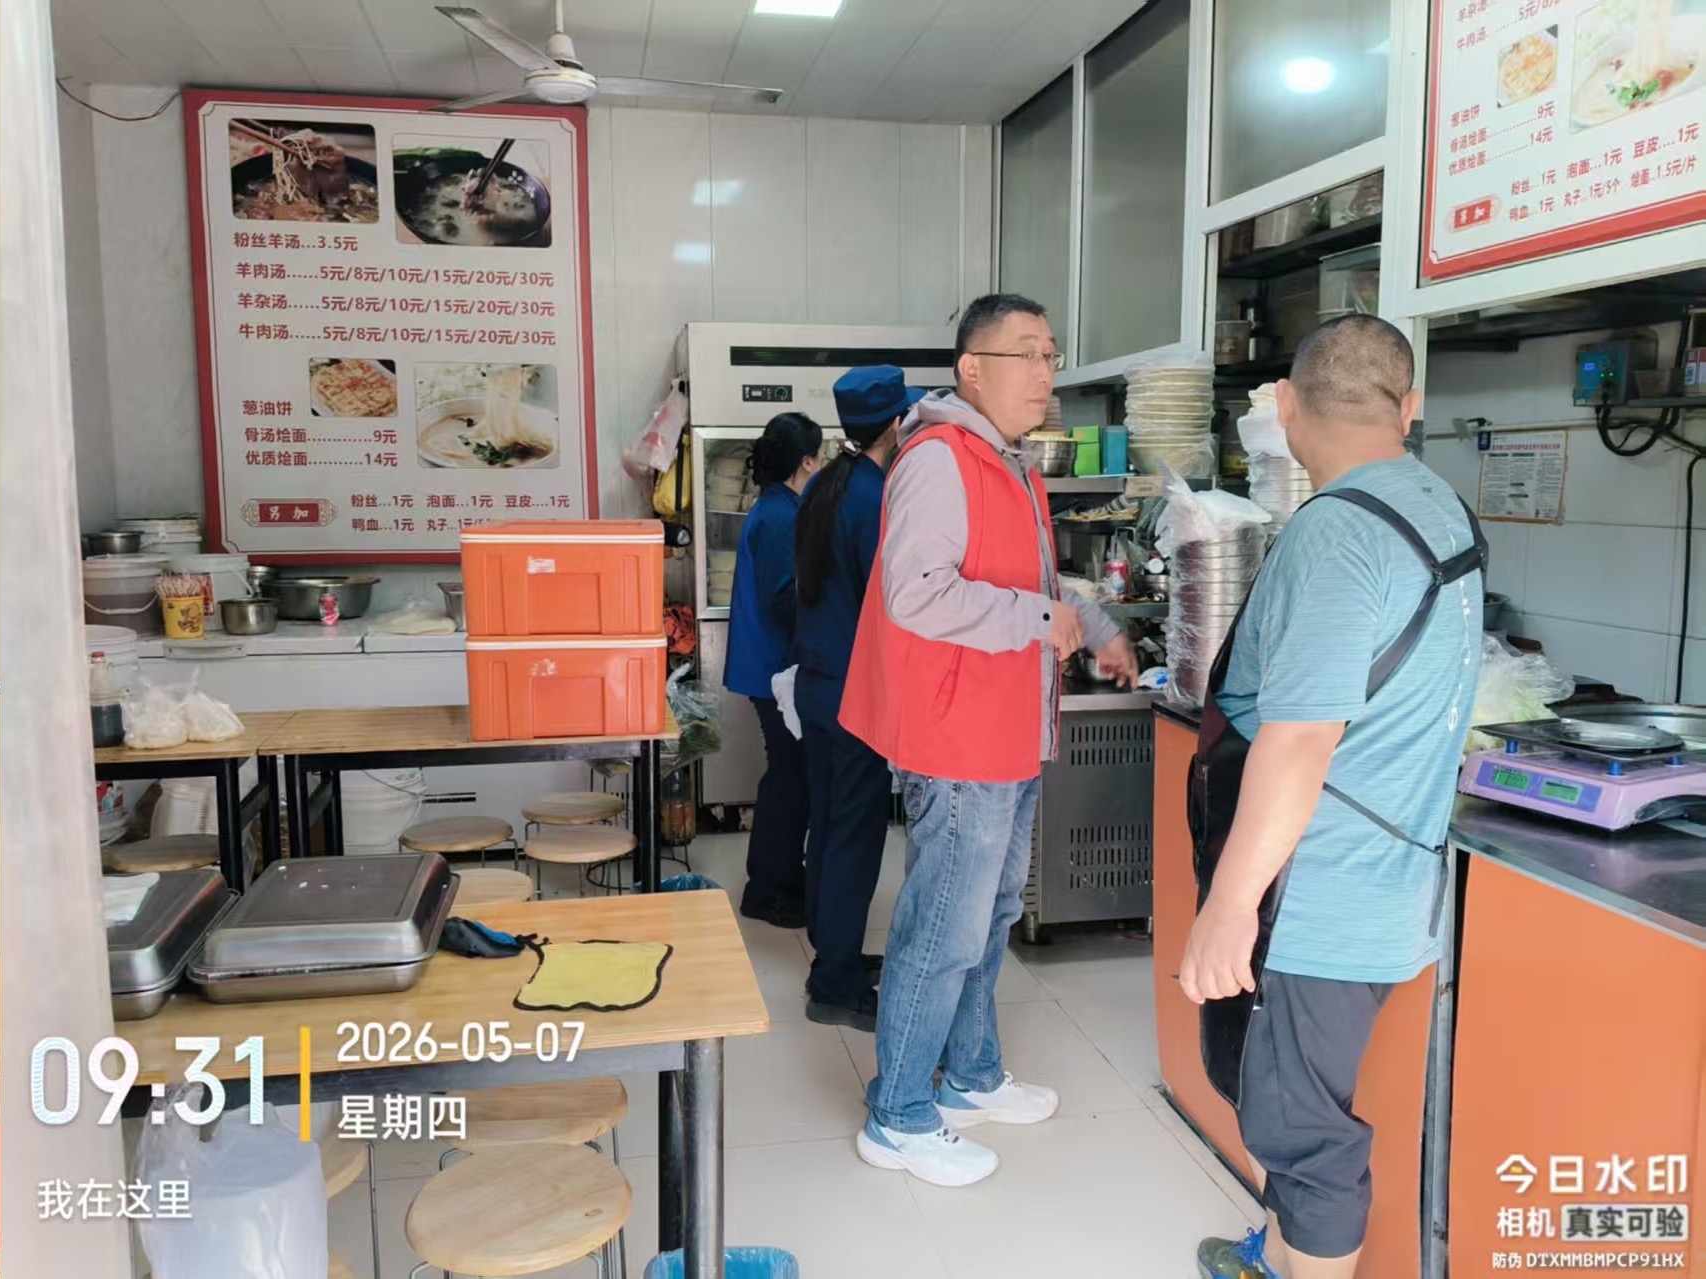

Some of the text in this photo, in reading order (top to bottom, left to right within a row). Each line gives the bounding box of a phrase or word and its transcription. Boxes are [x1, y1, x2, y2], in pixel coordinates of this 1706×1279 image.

[242, 400, 292, 416] 葱油饼
[269, 507, 309, 522] 另加
